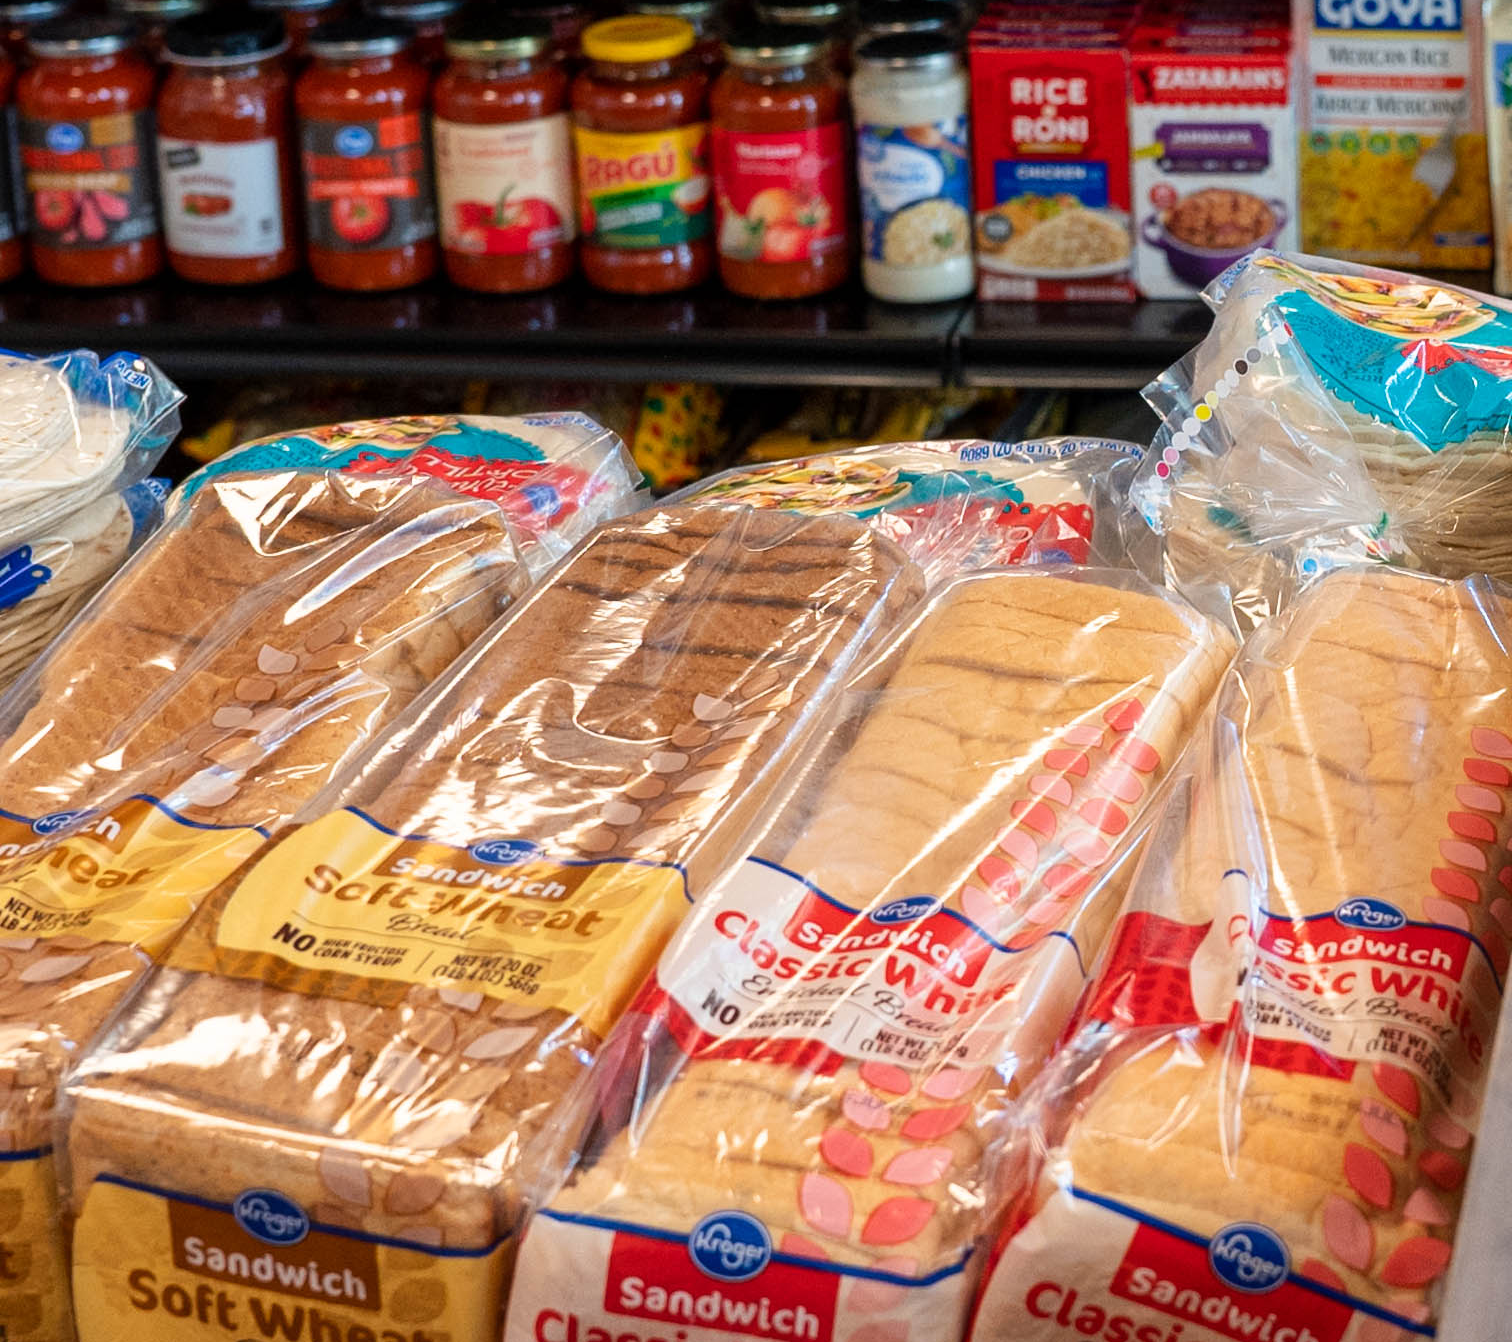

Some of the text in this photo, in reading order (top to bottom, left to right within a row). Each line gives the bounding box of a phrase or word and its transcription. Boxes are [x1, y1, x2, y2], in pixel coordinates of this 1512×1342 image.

[1412, 46, 1451, 68] RICE
[1011, 78, 1087, 104] RICE
[1153, 66, 1285, 93] ZATARAIN'S
[1016, 166, 1086, 181] CHICKEN
[695, 1224, 766, 1268] Kroger
[184, 1236, 368, 1302] Sandwich
[127, 1268, 238, 1332] Soft
[619, 1276, 820, 1340] Sandwich
